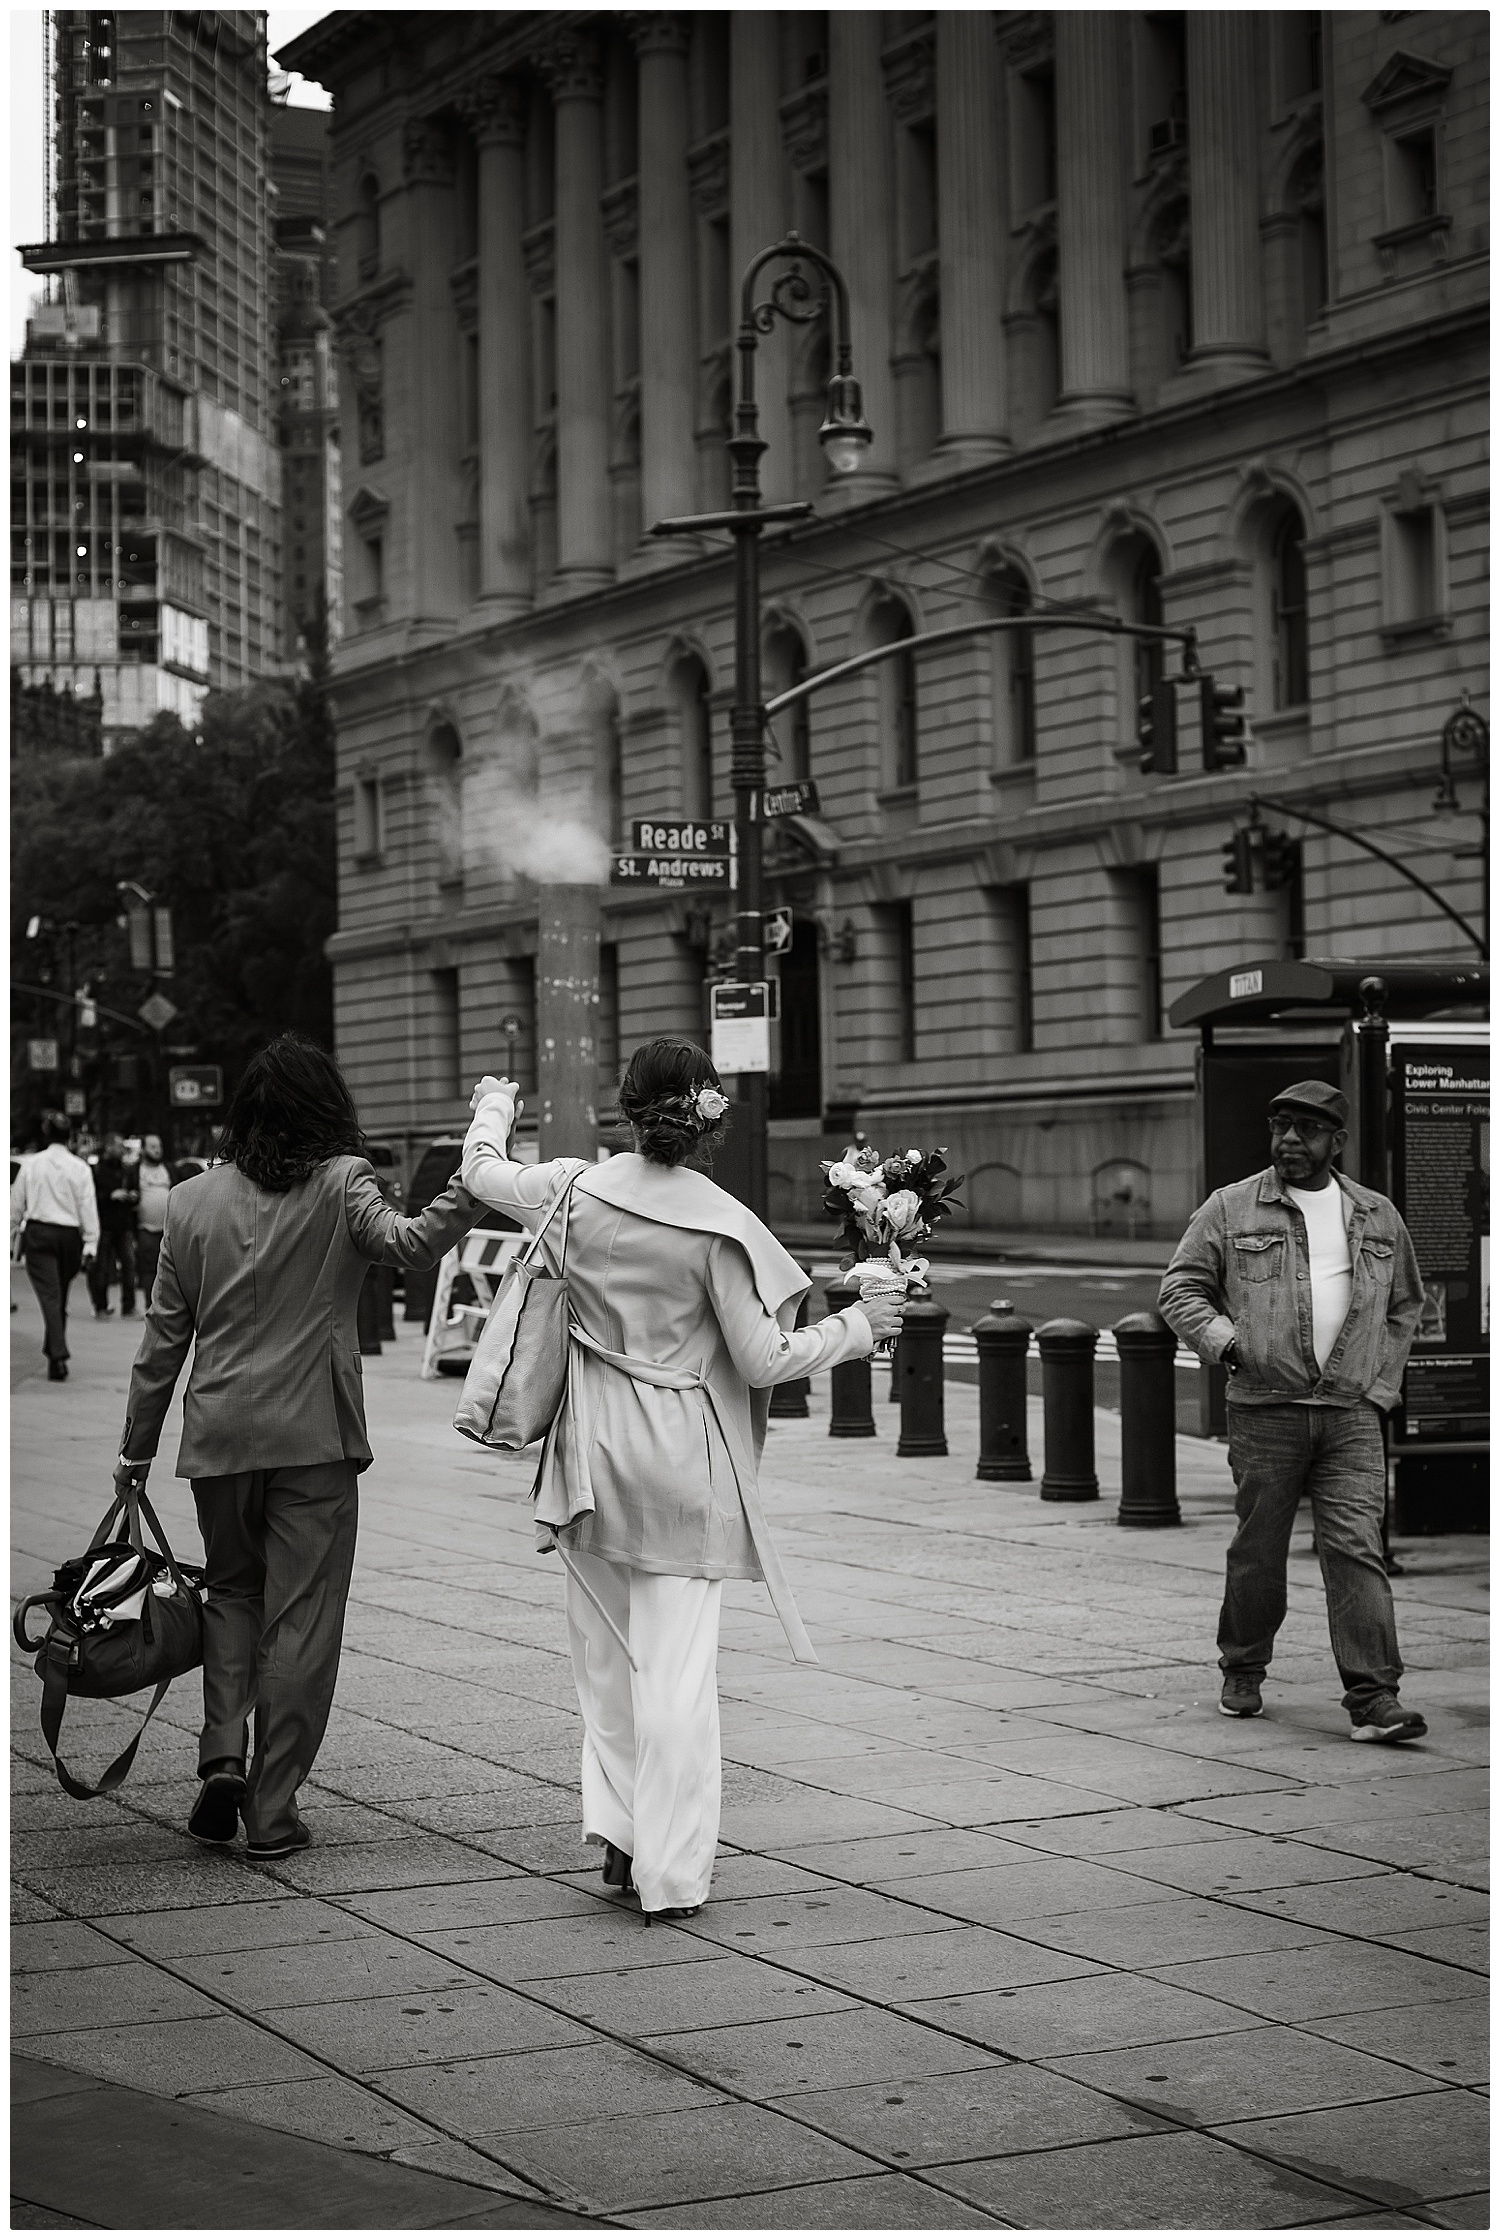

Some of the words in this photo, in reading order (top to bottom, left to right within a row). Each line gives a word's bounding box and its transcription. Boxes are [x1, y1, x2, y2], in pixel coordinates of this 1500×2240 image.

[640, 823, 708, 850] Reade
[618, 858, 641, 876] St.
[647, 859, 725, 877] Andrews
[1405, 1063, 1453, 1077] Exploring
[1405, 1077, 1437, 1088] Lower
[1404, 1103, 1430, 1115] Civic
[1431, 1103, 1464, 1115] Center
